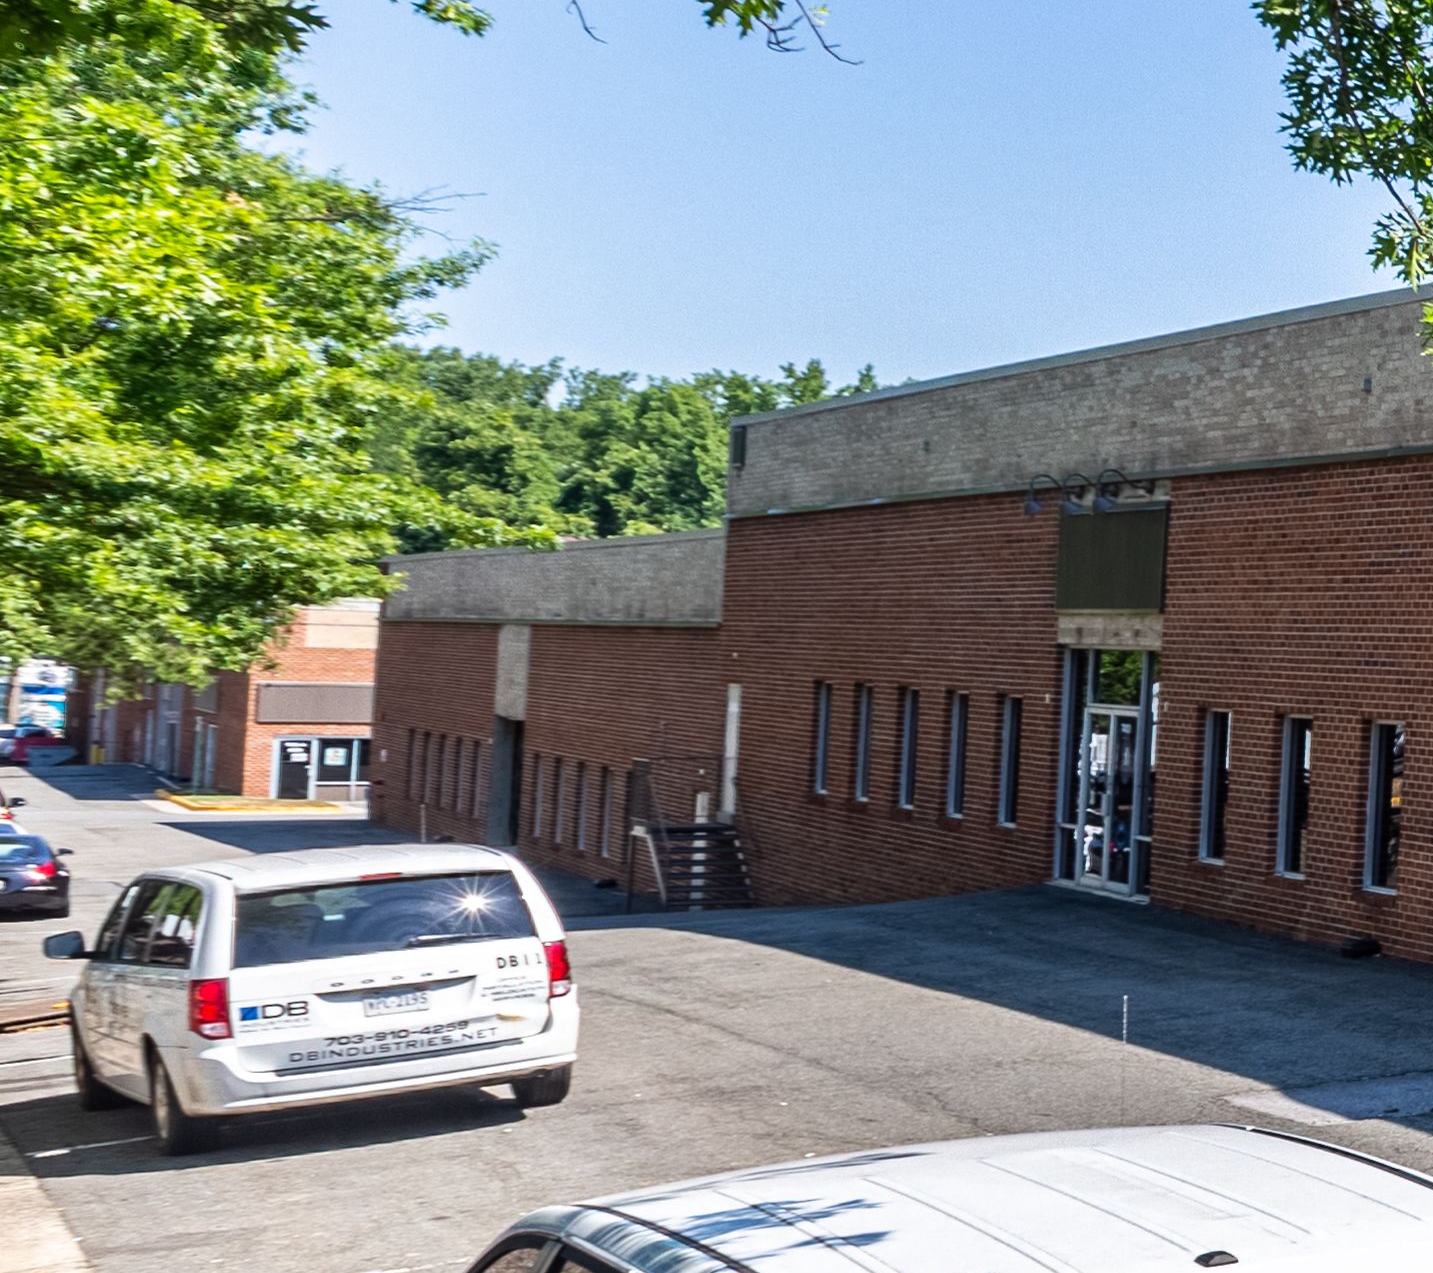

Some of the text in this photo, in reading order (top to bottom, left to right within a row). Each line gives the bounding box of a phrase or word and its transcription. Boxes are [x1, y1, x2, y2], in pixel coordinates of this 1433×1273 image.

[262, 1001, 308, 1019] DB
[290, 1027, 498, 1062] DBINDUSTRIES.NET
[324, 1020, 470, 1046] 703-910-4259
